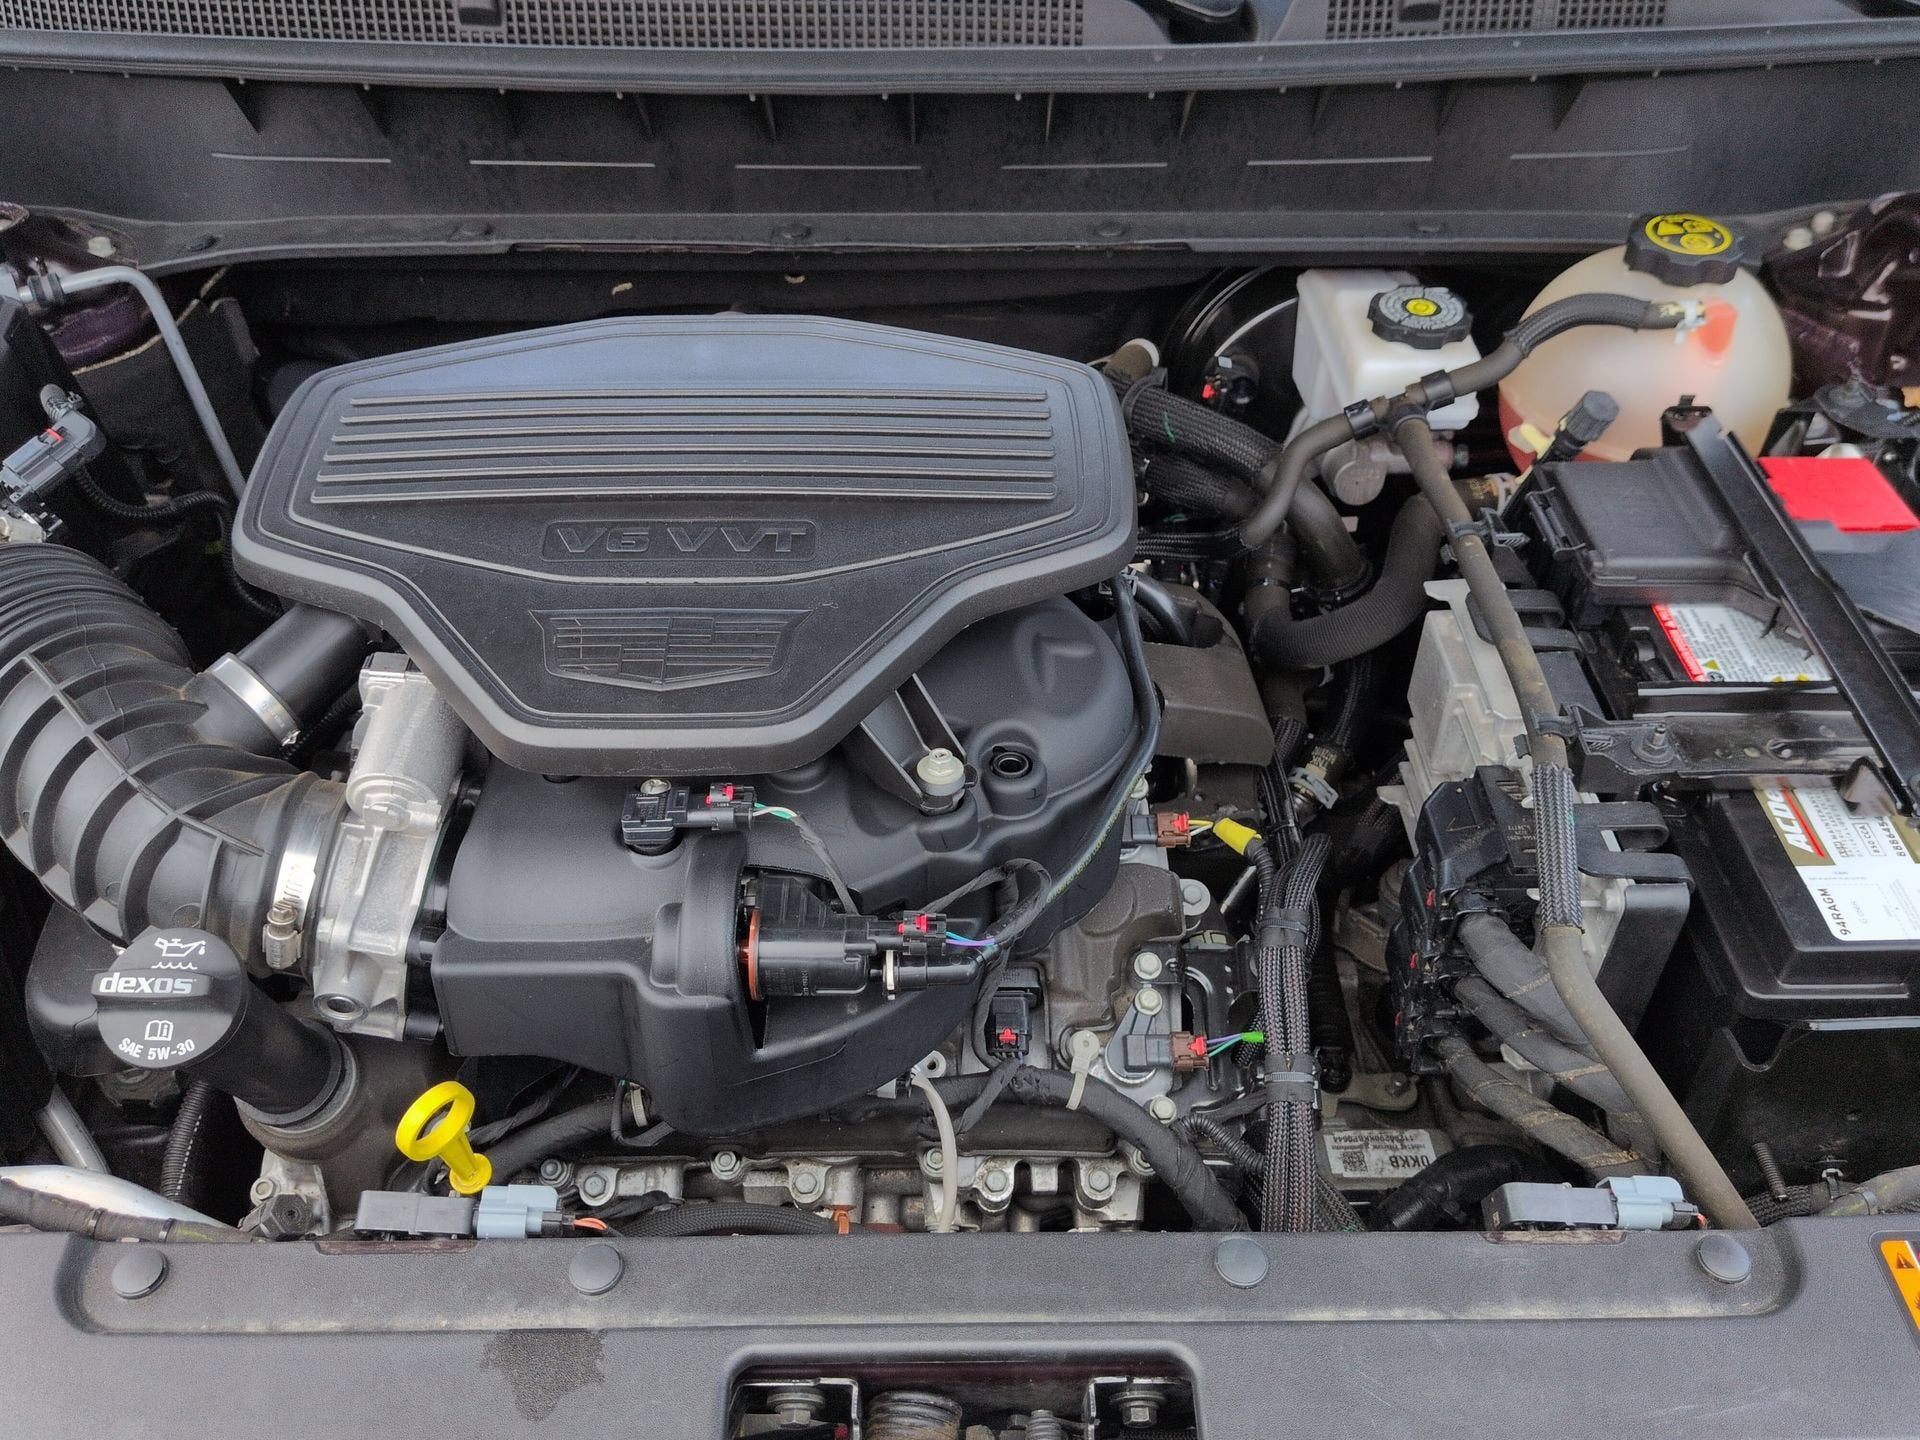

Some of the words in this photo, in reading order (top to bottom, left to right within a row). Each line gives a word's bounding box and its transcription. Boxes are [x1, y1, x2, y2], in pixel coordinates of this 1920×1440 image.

[557, 527, 650, 553] V6
[666, 527, 807, 553] VVT
[1817, 888, 1852, 935] 94RAGM
[100, 972, 193, 994] dexos
[118, 1037, 144, 1058] SAE
[147, 1039, 195, 1060] 5W-30
